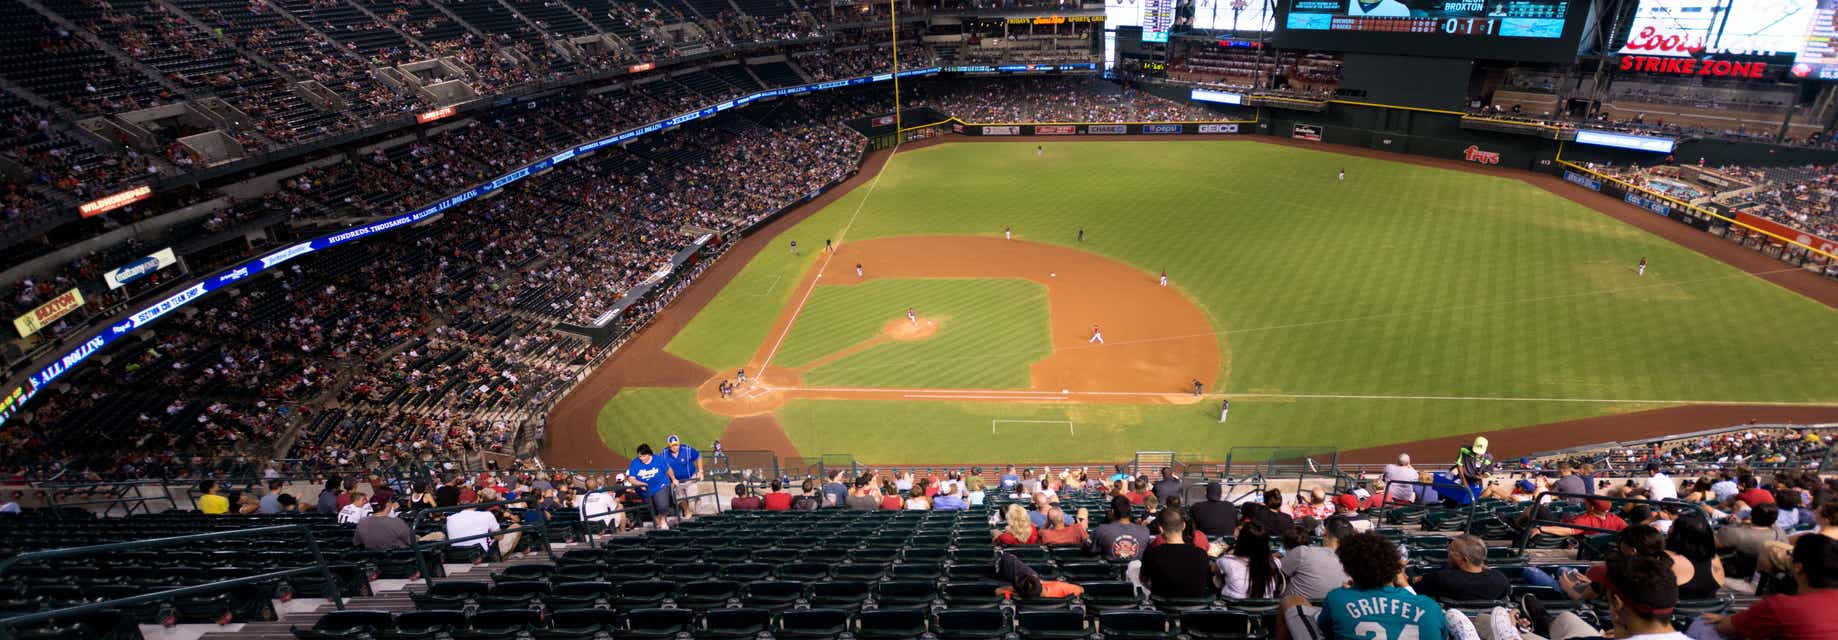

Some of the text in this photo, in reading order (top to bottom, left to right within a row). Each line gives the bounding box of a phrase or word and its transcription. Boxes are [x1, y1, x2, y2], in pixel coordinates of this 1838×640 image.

[1444, 2, 1484, 11] BROXTON
[1446, 18, 1458, 34] 0
[1466, 18, 1475, 35] 1
[1486, 18, 1496, 35] 1
[1627, 26, 1705, 52] Coors
[1620, 56, 1767, 78] STRIKE ZONE
[1200, 125, 1238, 134] GEICO
[41, 335, 105, 385] ALL ROLLING
[1345, 596, 1426, 623] GRIFFEY
